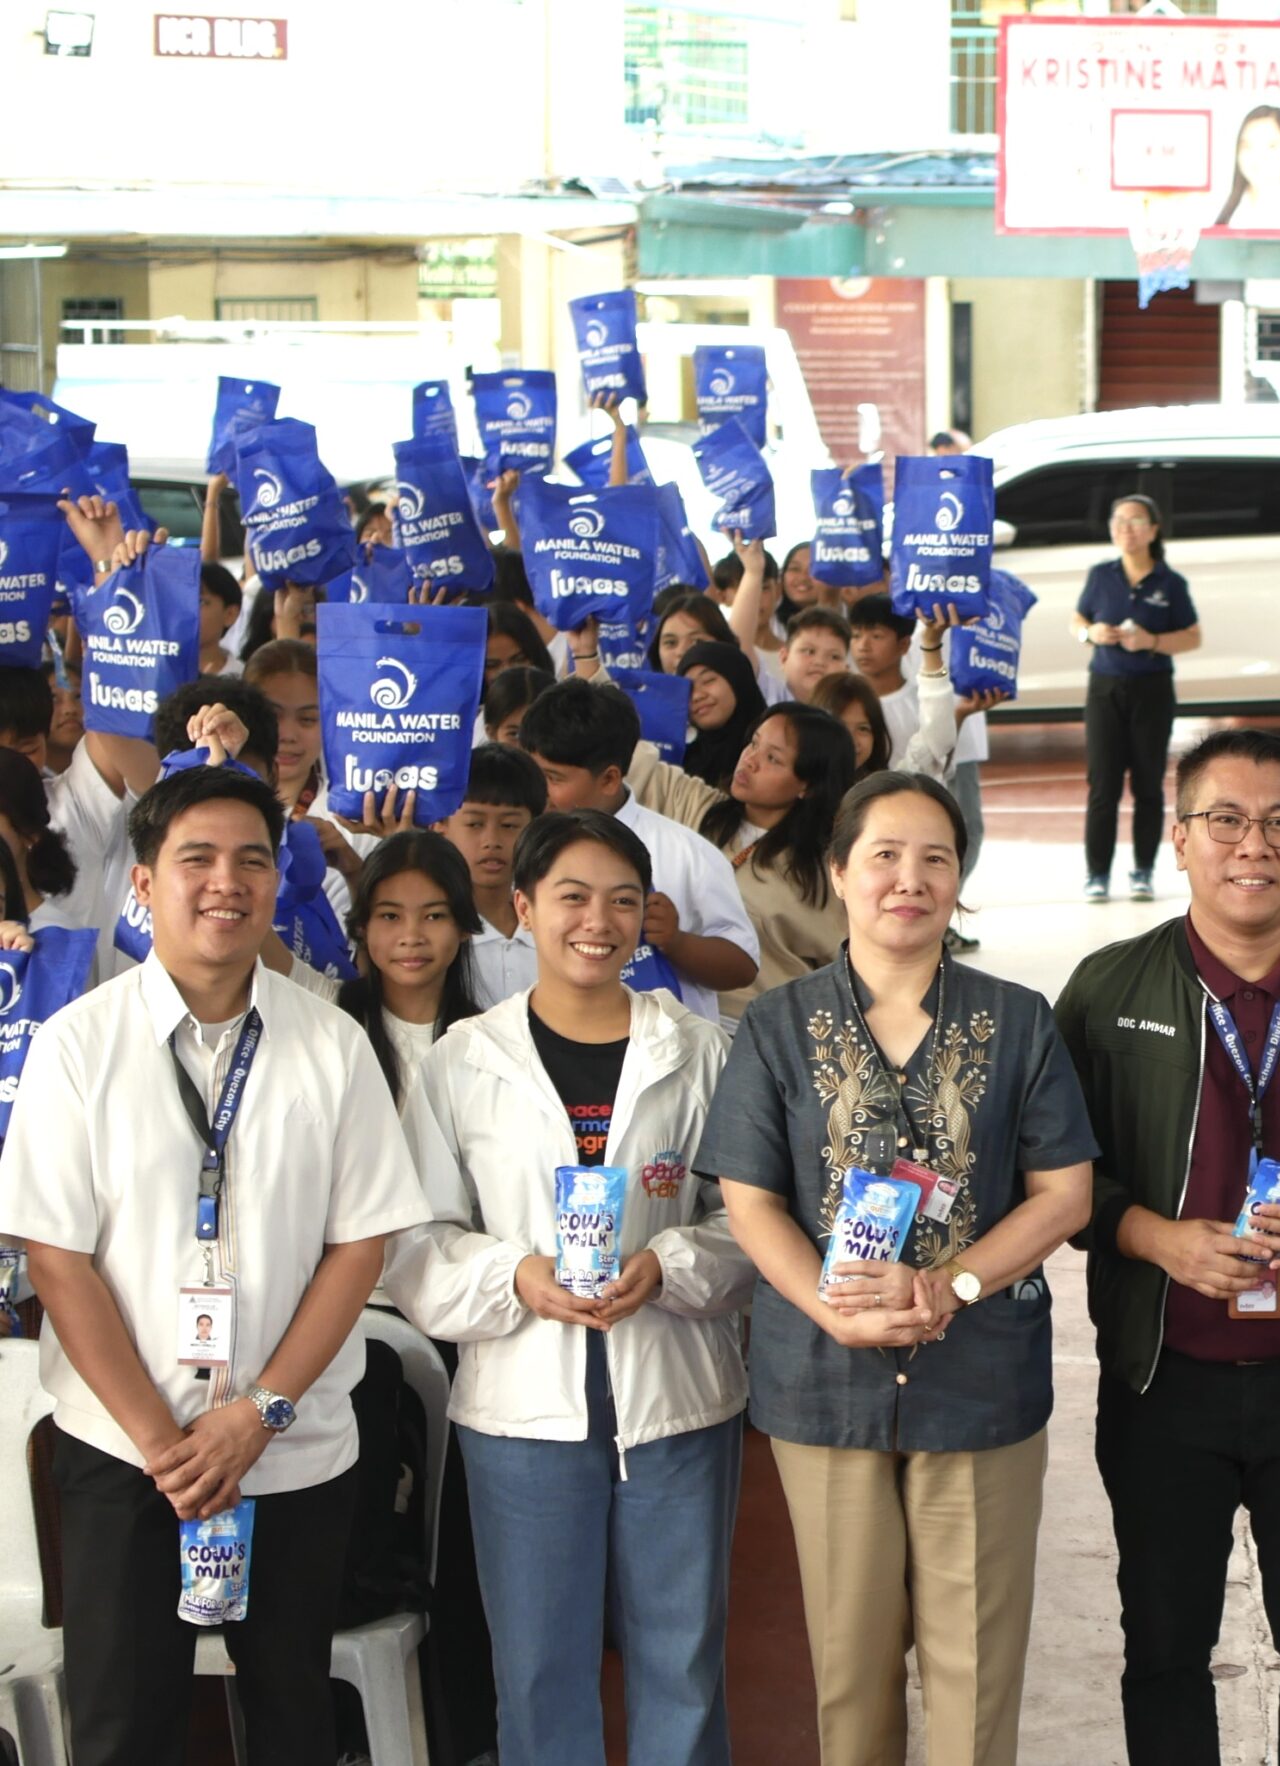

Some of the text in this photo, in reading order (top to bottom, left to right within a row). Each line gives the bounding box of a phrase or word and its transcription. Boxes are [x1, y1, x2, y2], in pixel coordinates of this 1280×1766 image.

[1020, 57, 1163, 91] KRISTINE
[419, 512, 463, 533] WATER
[534, 538, 641, 560] MANILA WATER
[903, 533, 948, 546] MANILA
[554, 550, 621, 565] FOUNDATION
[916, 546, 975, 557] FOUNDATION
[126, 638, 180, 657] WATER
[92, 651, 156, 668] FOUNDATION
[336, 711, 461, 731] MANILA WATER
[351, 731, 435, 744] FOUNDATION
[1117, 1017, 1176, 1037] DOC AMMAR
[240, 1026, 258, 1058] Office
[1210, 1001, 1228, 1027] ffice
[1224, 1032, 1246, 1075] Quezon
[1258, 1049, 1275, 1087] Schools
[223, 1068, 247, 1108] Quezon
[214, 1108, 232, 1132] City
[559, 1210, 614, 1231] COW'S
[563, 1232, 608, 1248] MILK
[845, 1240, 891, 1261] MILK
[188, 1541, 246, 1563] COW'S
[195, 1564, 240, 1579] MILK
